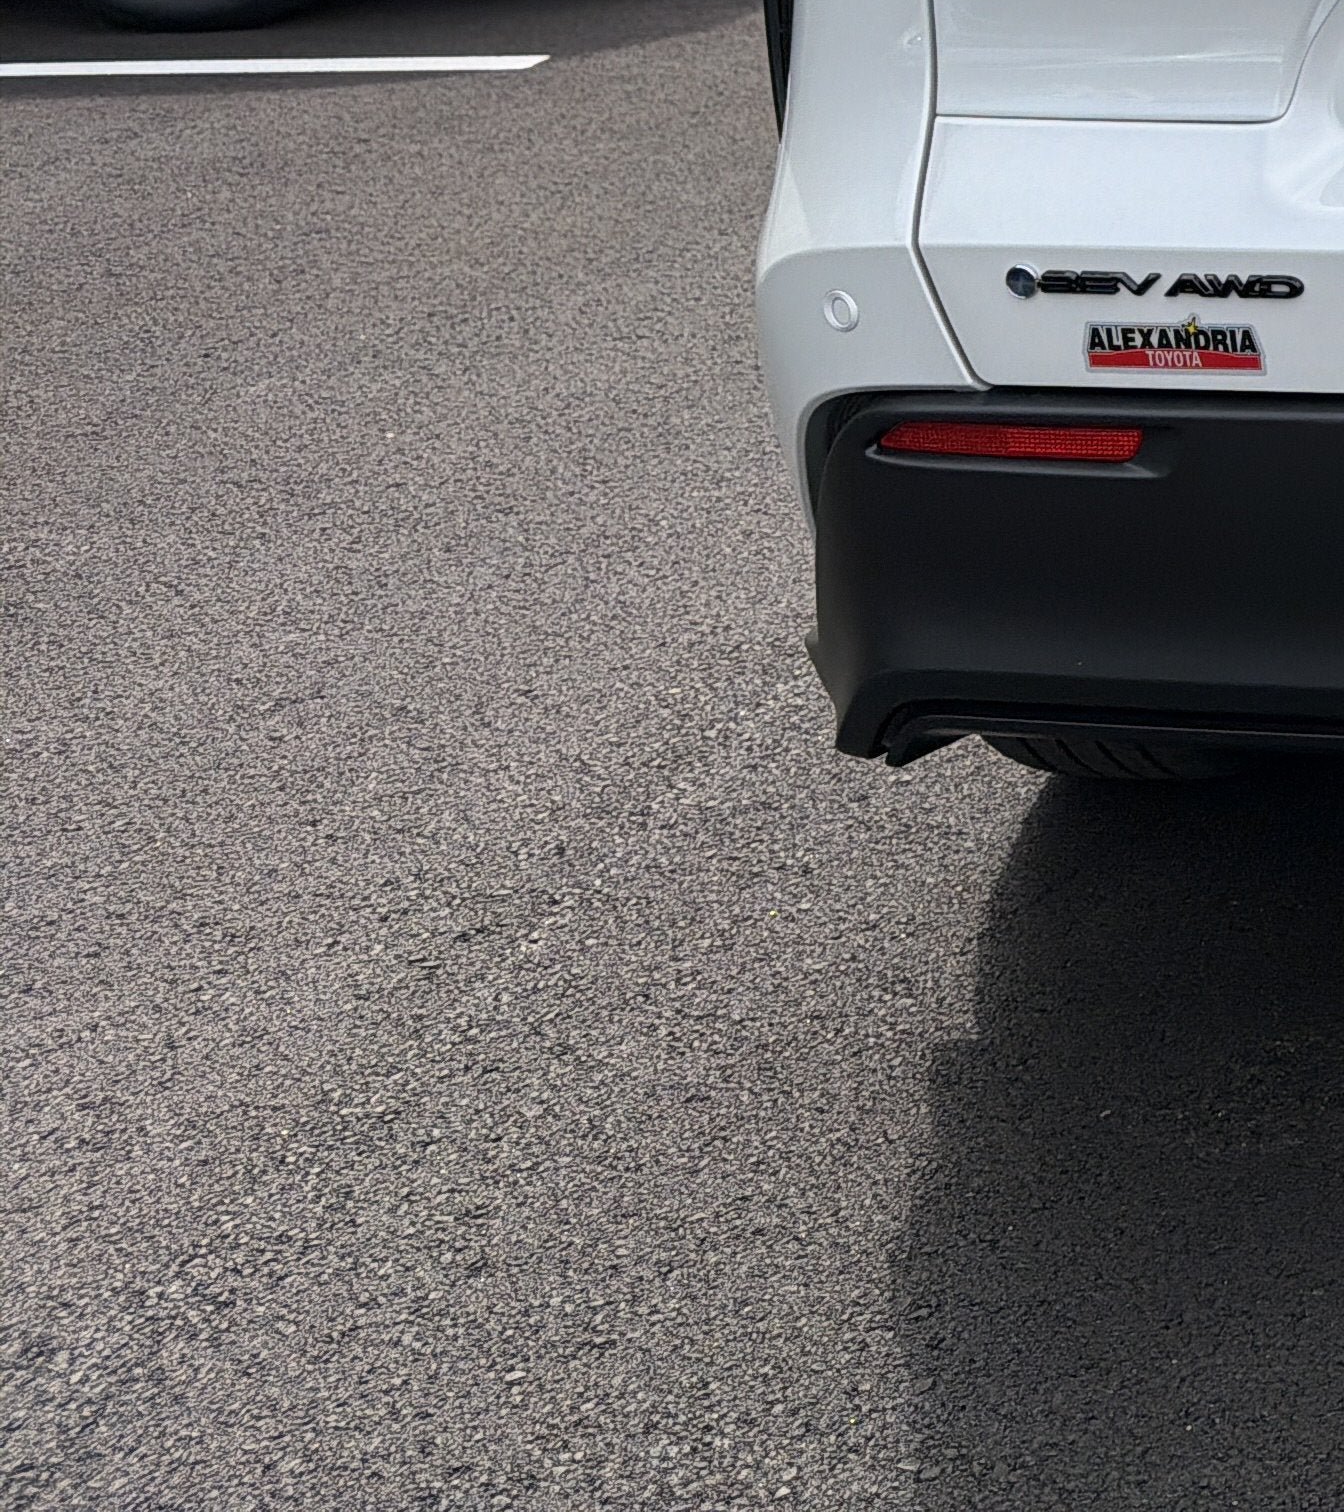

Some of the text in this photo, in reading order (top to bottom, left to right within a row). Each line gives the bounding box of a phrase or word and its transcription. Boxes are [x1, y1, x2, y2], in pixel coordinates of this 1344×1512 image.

[1164, 272, 1305, 299] AWD
[1089, 325, 1259, 353] ALEXANDRIA
[1145, 350, 1203, 368] TOYOTA
